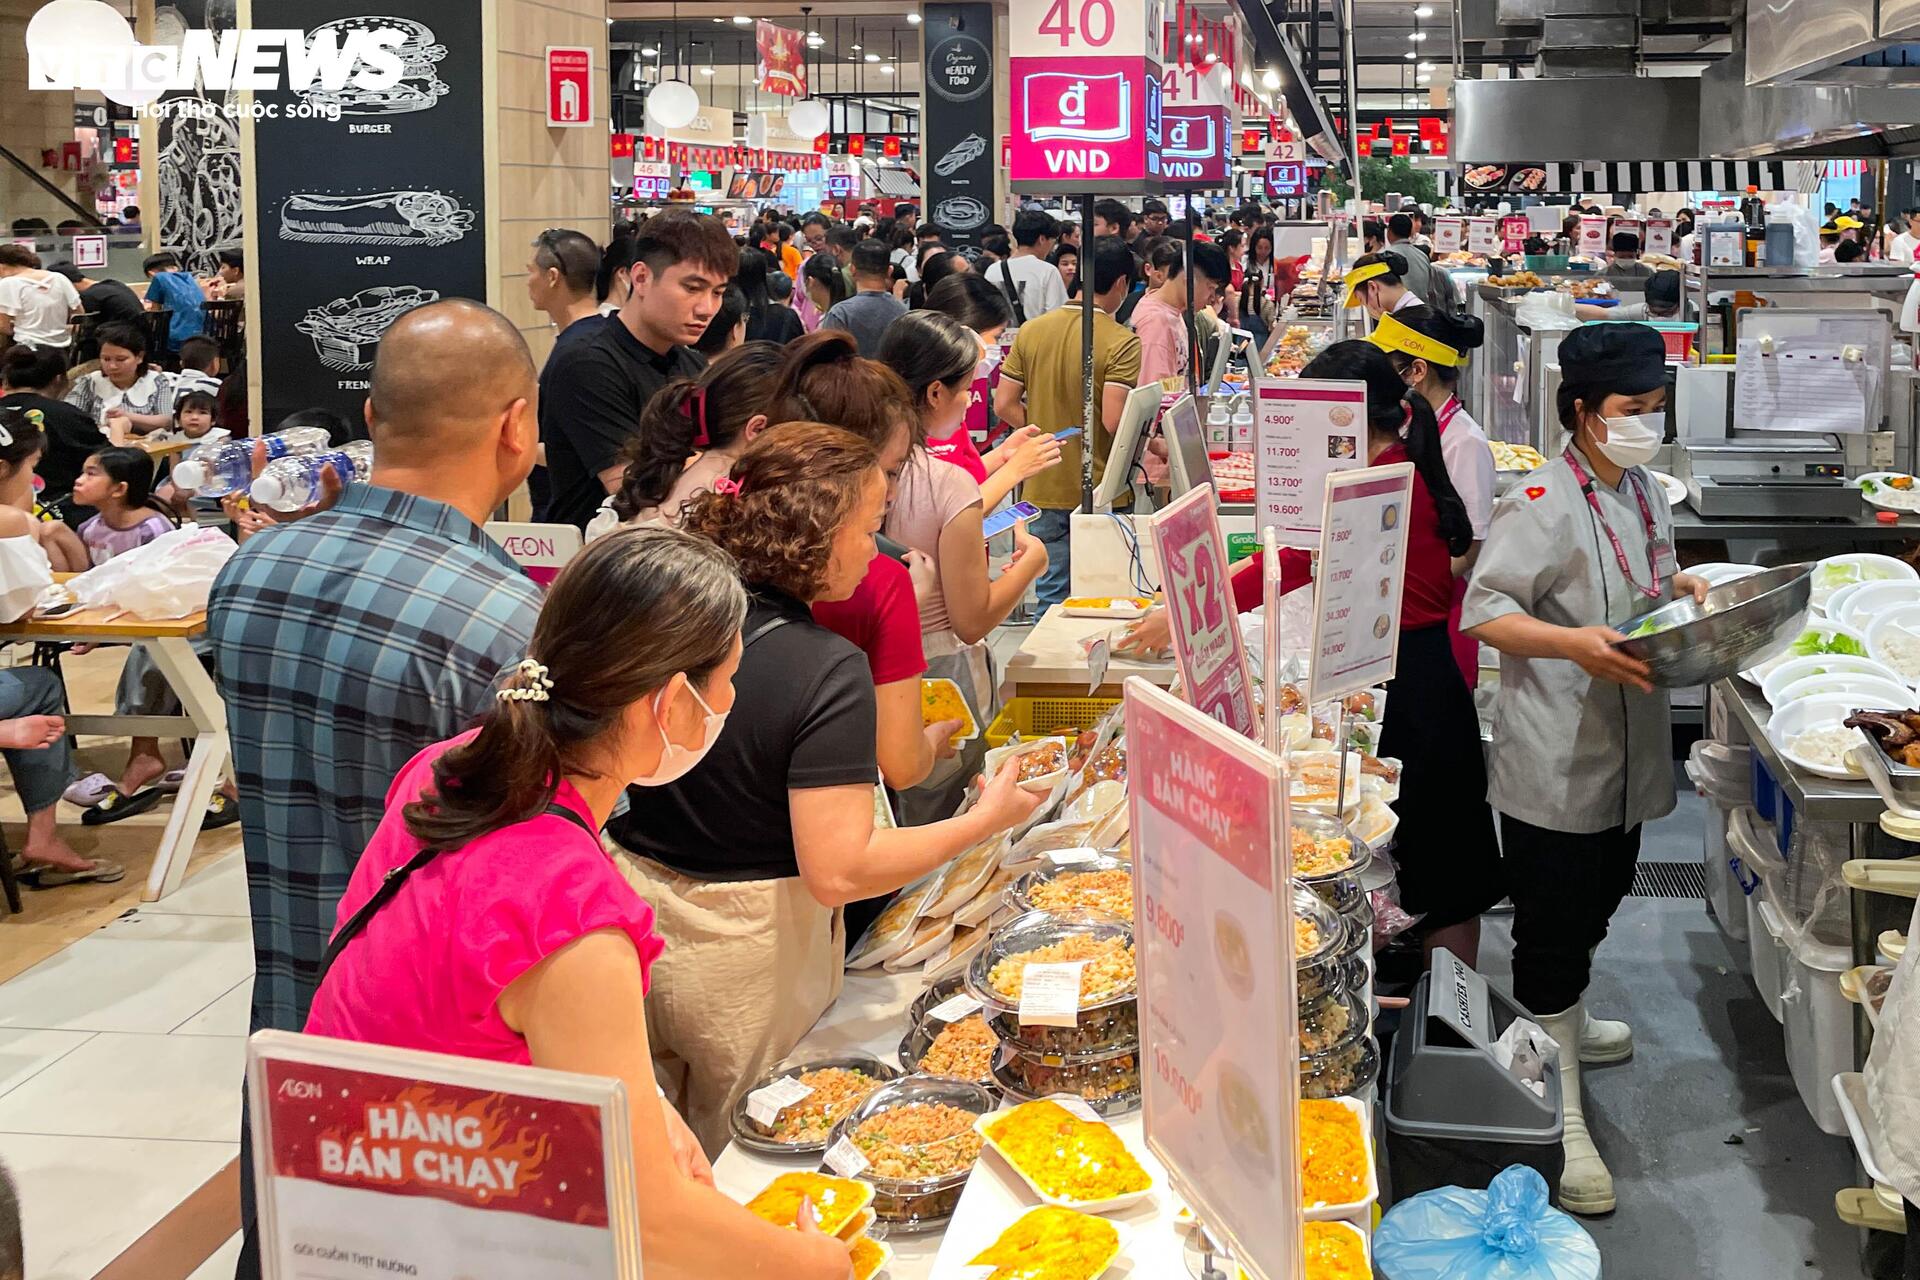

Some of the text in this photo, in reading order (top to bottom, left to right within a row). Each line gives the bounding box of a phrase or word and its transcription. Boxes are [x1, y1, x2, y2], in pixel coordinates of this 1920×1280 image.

[1037, 0, 1116, 48] 40
[945, 65, 977, 76] HEALTHY
[949, 76, 970, 85] FOOD
[1161, 69, 1199, 101] 41
[349, 123, 392, 134] BURGER
[1273, 145, 1294, 159] 42
[639, 163, 654, 174] 46
[1044, 149, 1111, 173] VND
[1161, 162, 1204, 178] VND
[1275, 186, 1296, 195] VND
[355, 255, 392, 266] WRAP
[1169, 750, 1217, 799] HÀNG
[1456, 983, 1473, 1030] CASHIER
[369, 1101, 483, 1149] HÀNG
[320, 1136, 520, 1199] BÁN CHẠY
